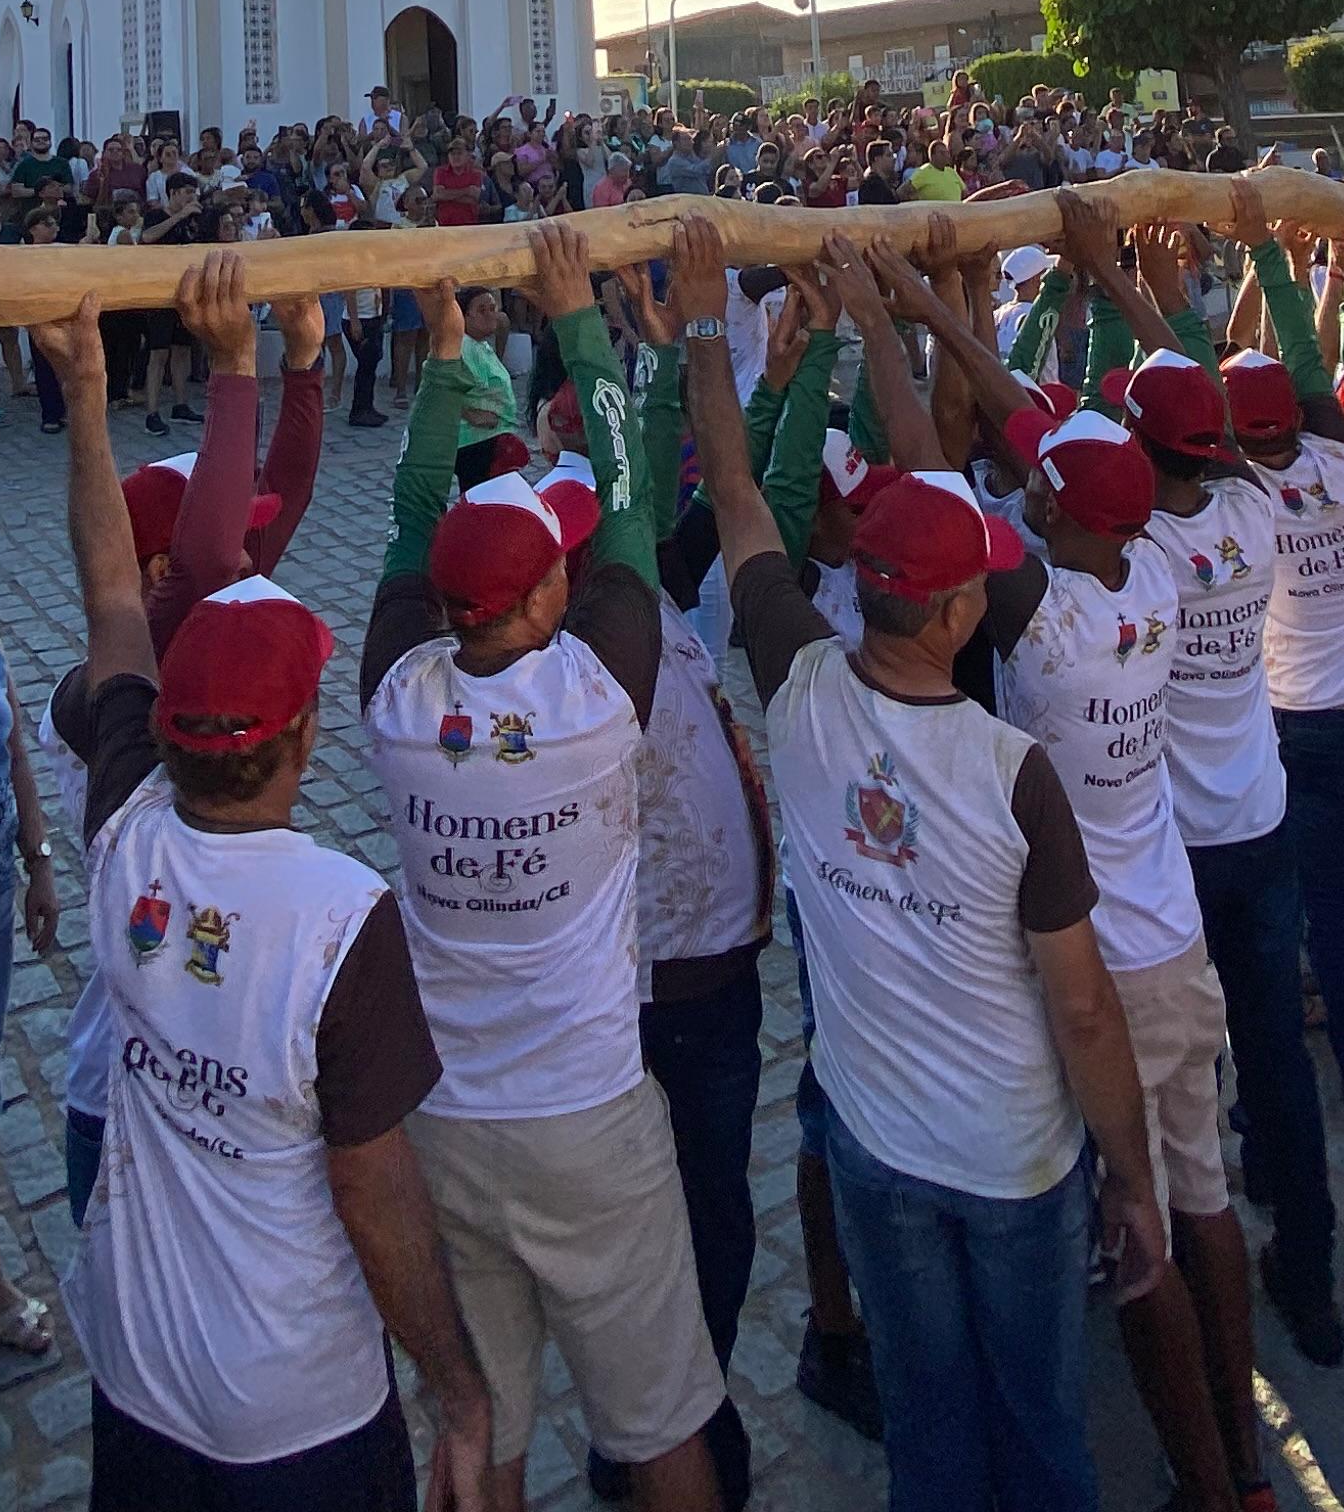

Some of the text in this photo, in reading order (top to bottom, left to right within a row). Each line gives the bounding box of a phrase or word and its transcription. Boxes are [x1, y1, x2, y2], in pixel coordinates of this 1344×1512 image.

[1298, 556, 1328, 577] de
[1185, 634, 1221, 657] de
[1107, 732, 1139, 759] de
[1084, 773, 1123, 788] Nova
[405, 793, 580, 840] Homens
[430, 846, 548, 883] de Fé
